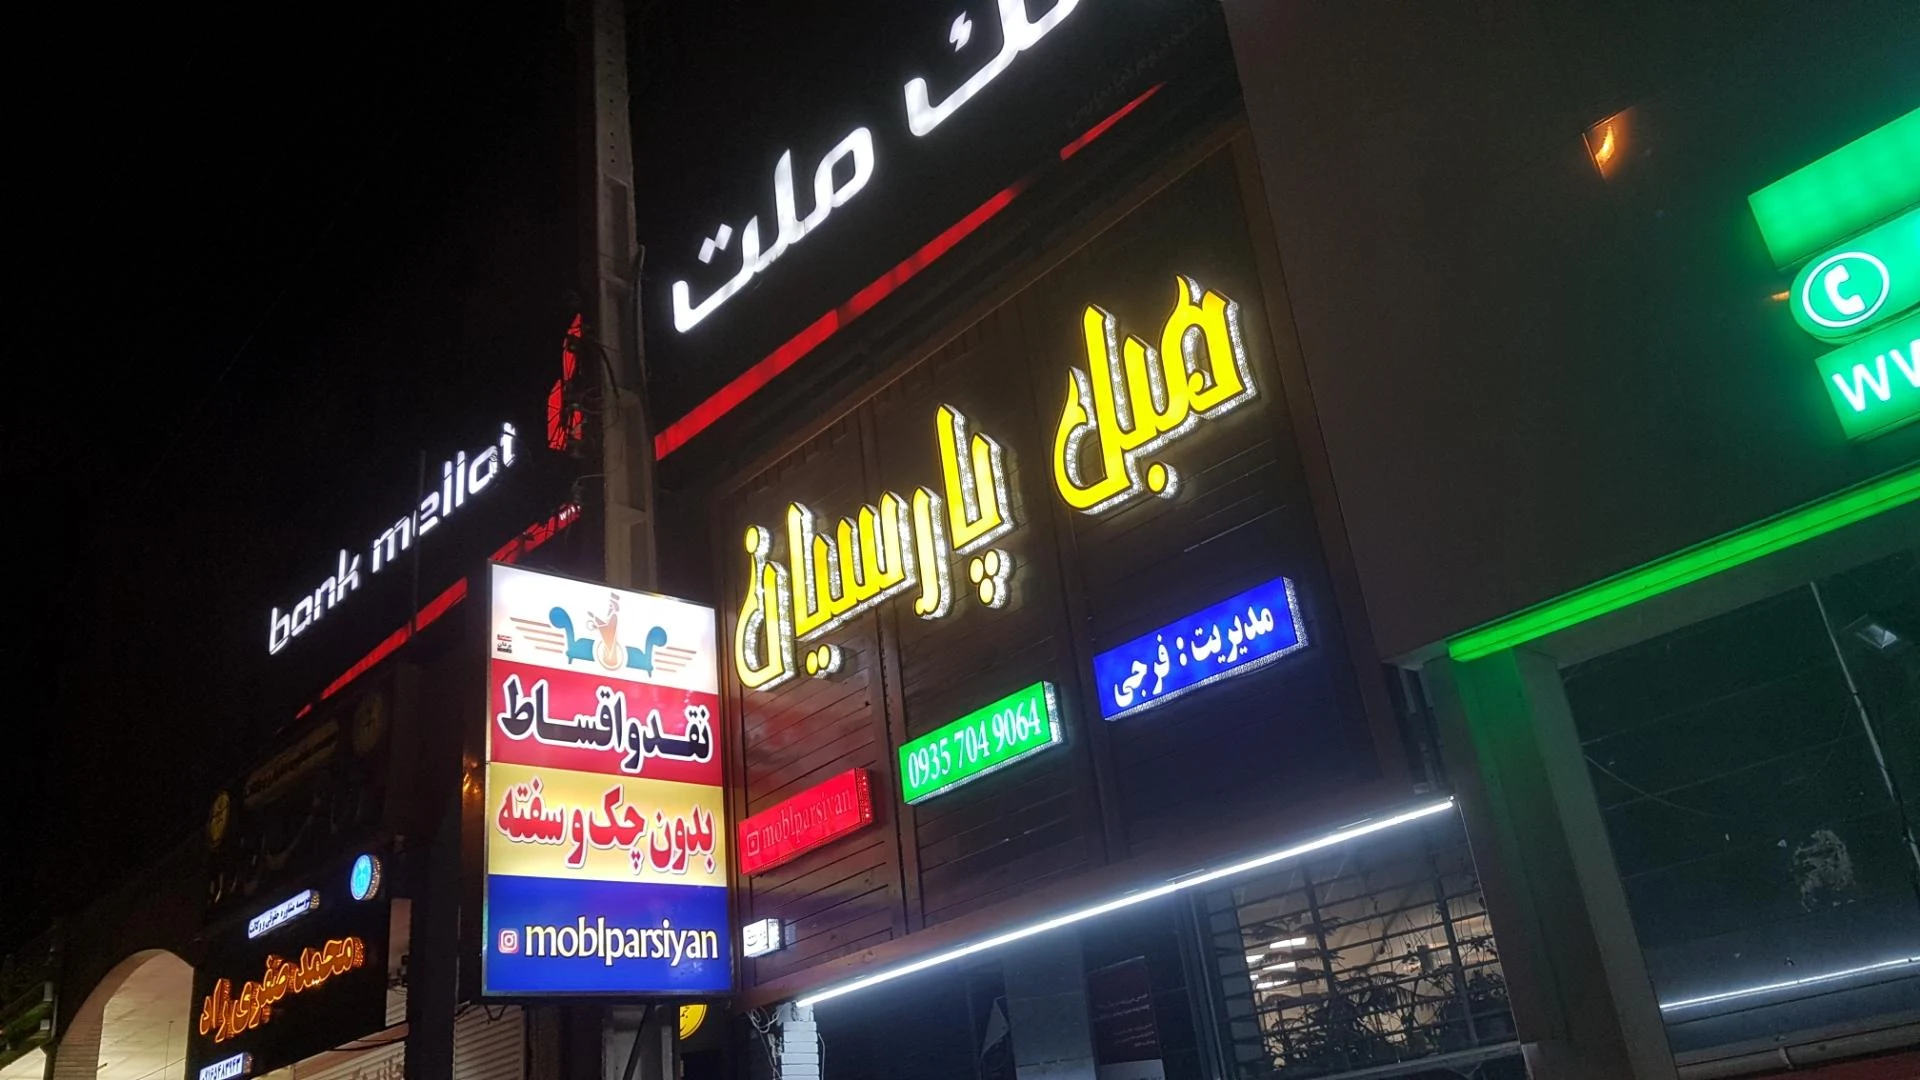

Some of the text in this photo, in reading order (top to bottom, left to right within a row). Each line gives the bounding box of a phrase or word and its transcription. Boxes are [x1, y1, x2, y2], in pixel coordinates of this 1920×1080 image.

[672, 126, 875, 333] ملت
[734, 273, 1250, 690] مبل پارسیان
[269, 548, 361, 656] bank
[1114, 633, 1170, 708] فرجی
[907, 697, 1043, 788] 0935 704 9064
[499, 778, 714, 873] بدون چک و سفته
[294, 936, 354, 994] محمد
[525, 916, 719, 966] moblparsiyan
